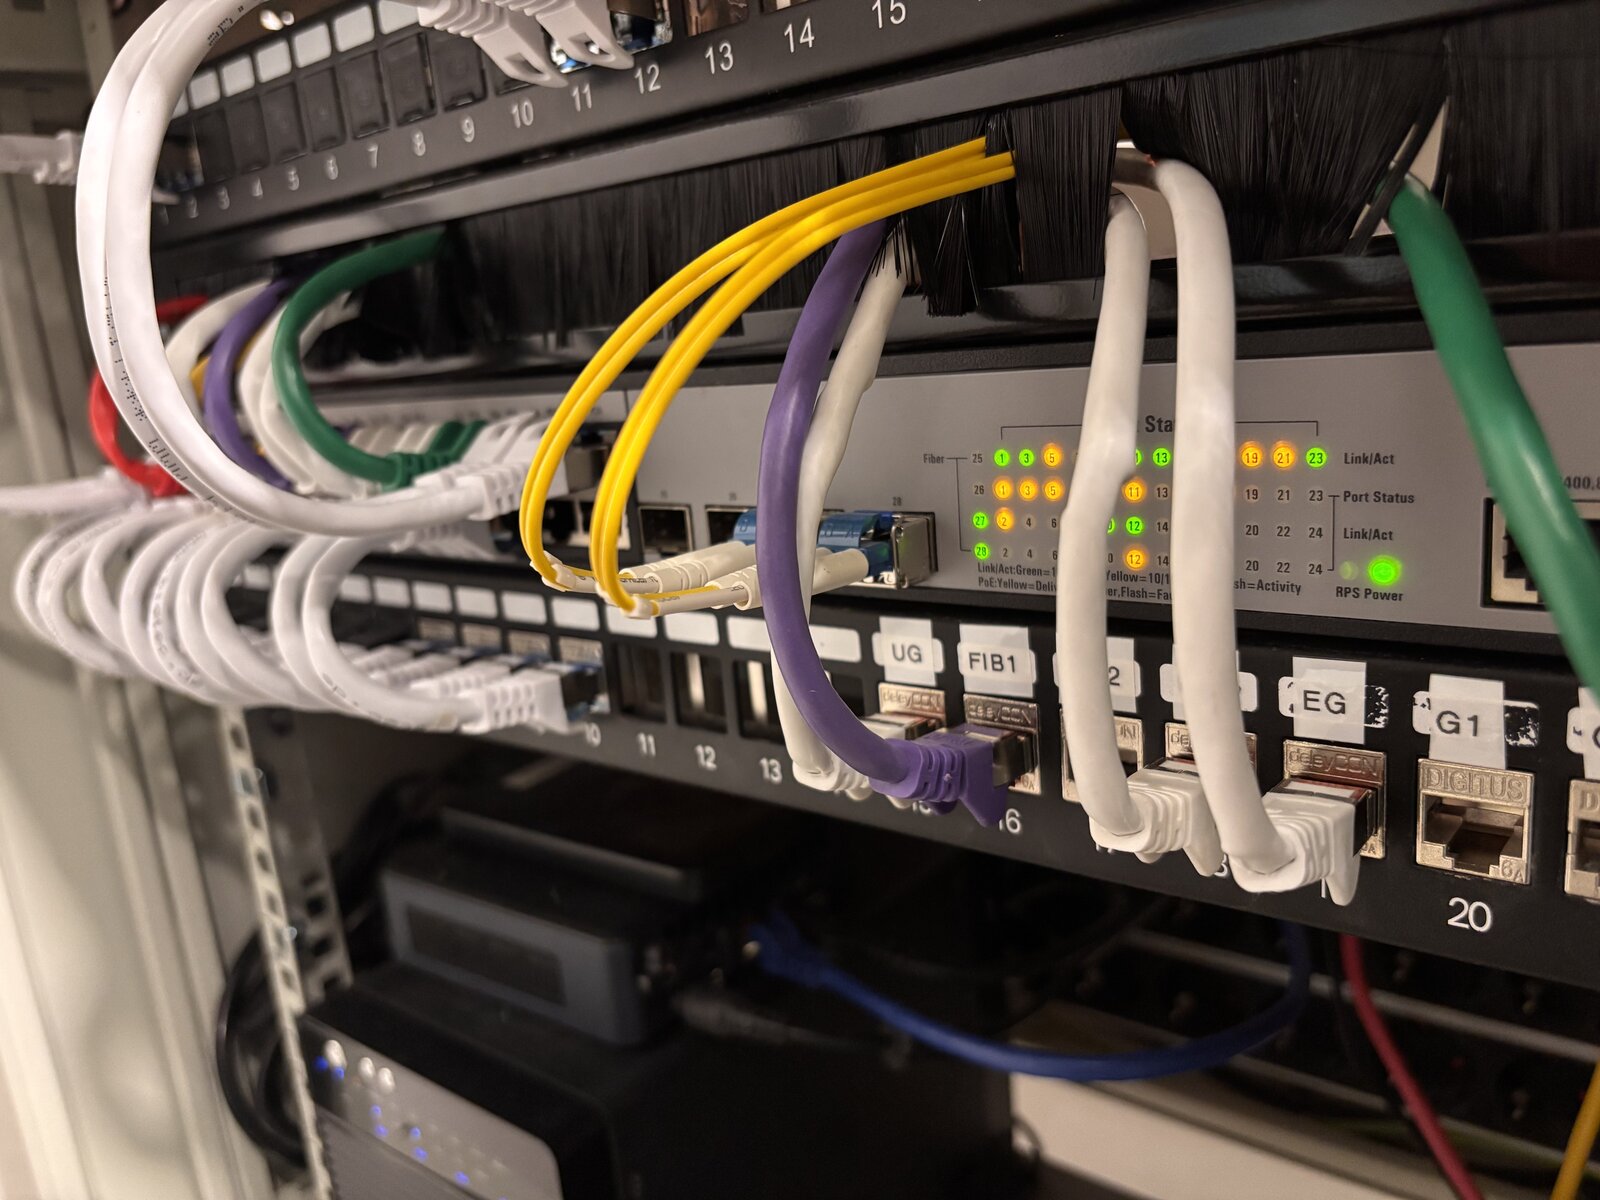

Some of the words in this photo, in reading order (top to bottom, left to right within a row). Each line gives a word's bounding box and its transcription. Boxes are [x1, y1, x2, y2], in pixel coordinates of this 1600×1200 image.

[367, 142, 379, 168] 7
[411, 129, 426, 156] 8
[461, 115, 475, 143] 9
[511, 98, 534, 128] 10
[571, 83, 593, 112] 11
[634, 63, 661, 94] 12
[705, 42, 734, 75] 13
[783, 17, 815, 53] 14
[871, 0, 907, 29] 15
[1144, 415, 1174, 433] Sta
[923, 453, 945, 464] Fiber
[972, 453, 983, 464] 25
[1156, 452, 1168, 464] 13
[1245, 452, 1258, 464] 19
[1277, 452, 1290, 464] 21
[1309, 452, 1323, 464] 23
[1343, 452, 1395, 465] Link/Act
[973, 485, 985, 495] 26
[1128, 486, 1140, 498] 11
[1156, 487, 1168, 498] 13
[1245, 488, 1258, 500] 19
[1277, 489, 1290, 501] 21
[1309, 490, 1323, 501] 23
[1343, 490, 1369, 503] Port
[1373, 491, 1415, 504] Status
[975, 516, 985, 526] 27
[1026, 517, 1032, 527] 4
[1051, 518, 1057, 528] 6
[1129, 520, 1140, 531] 12
[1156, 521, 1169, 532] 14
[1245, 524, 1259, 536] 20
[1276, 526, 1290, 537] 22
[1308, 527, 1323, 538] 24
[1343, 527, 1393, 541] Link/Act
[976, 546, 987, 556] 28
[1002, 547, 1008, 557] 2
[1027, 549, 1032, 558] 4
[1052, 550, 1058, 560] 6
[1107, 552, 1114, 563] 0
[1129, 554, 1141, 565] 12
[1157, 555, 1169, 566] 14
[1245, 560, 1259, 571] 20
[1276, 562, 1290, 573] 22
[1308, 563, 1323, 575] 24
[977, 562, 1056, 577] Link/Act:Green=1
[1106, 570, 1170, 585] Yellow=10/1
[1233, 578, 1302, 596] sh=Activity
[1335, 586, 1360, 599] RPS
[1364, 588, 1404, 602] Power
[891, 643, 922, 663] UG
[968, 652, 1016, 673] FIB1
[1303, 689, 1346, 715] EG
[1436, 710, 1479, 737] G1
[1420, 766, 1524, 801] DIGITUS
[583, 722, 601, 747] 10
[636, 732, 656, 757] 11
[694, 743, 718, 771] 12
[758, 756, 783, 784] 13
[1447, 896, 1492, 933] 20
[1501, 858, 1525, 883] 6A
